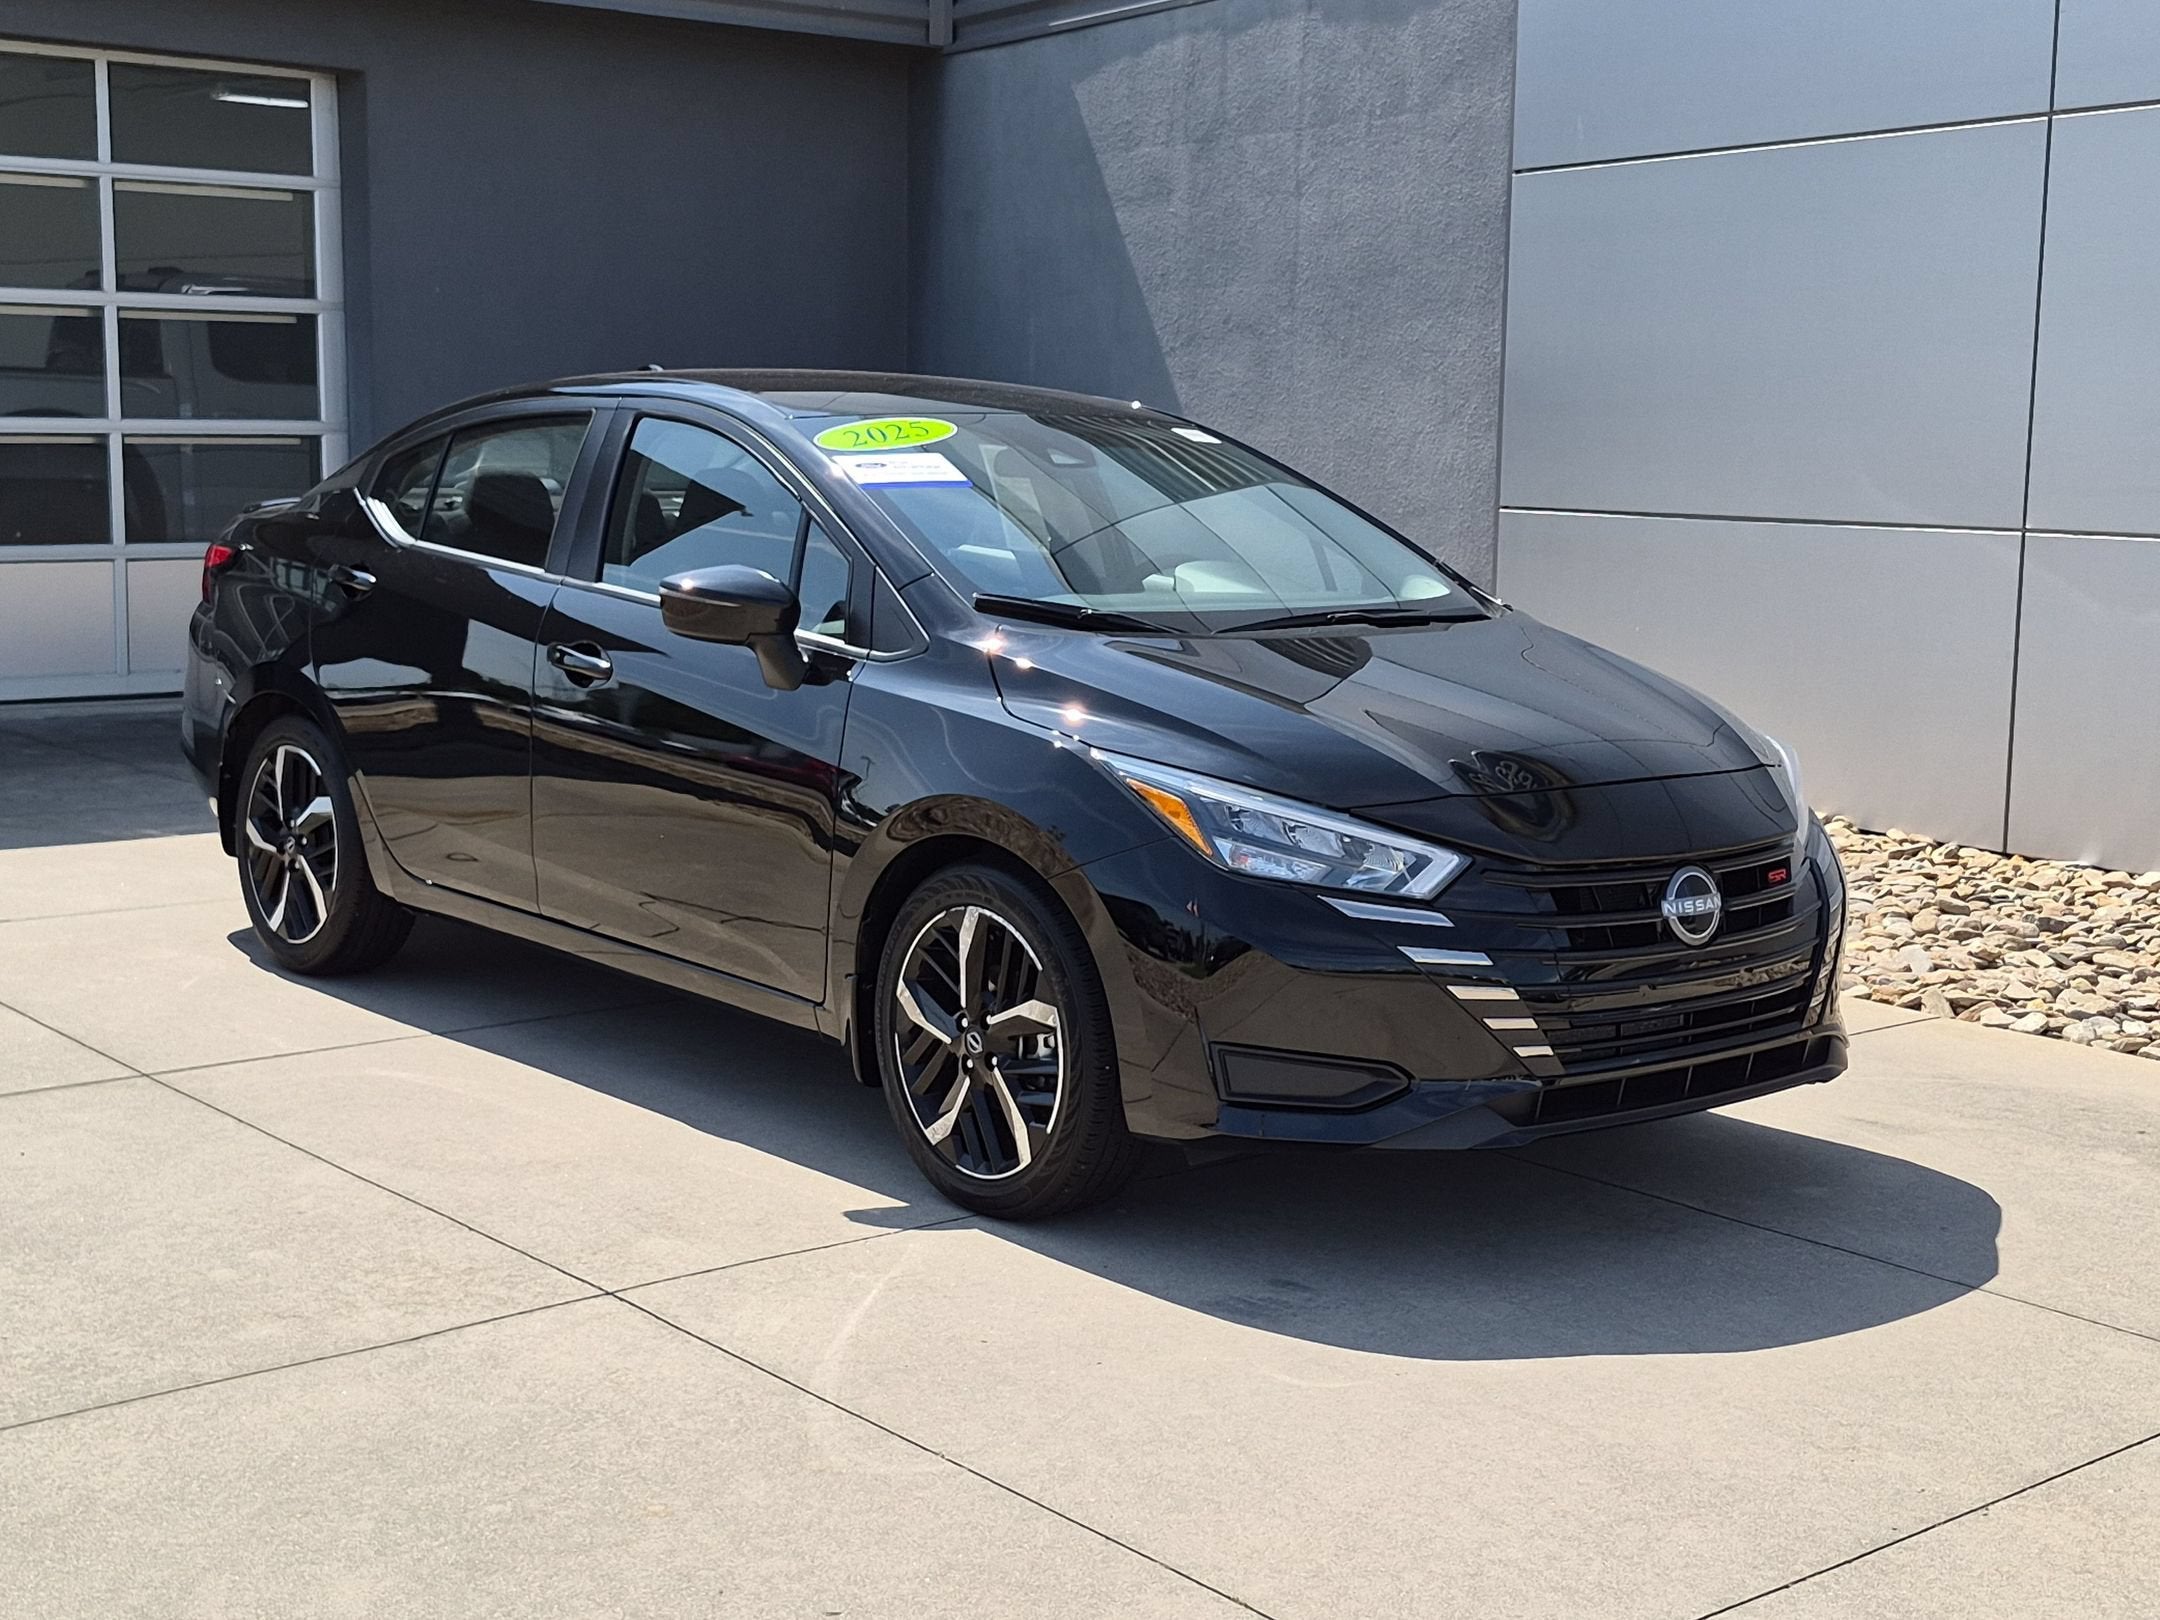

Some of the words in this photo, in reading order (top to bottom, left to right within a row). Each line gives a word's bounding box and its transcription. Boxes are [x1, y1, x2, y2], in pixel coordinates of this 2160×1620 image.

[843, 421, 930, 447] 2025
[1768, 868, 1787, 882] SR
[1663, 894, 1722, 914] NISSAN
